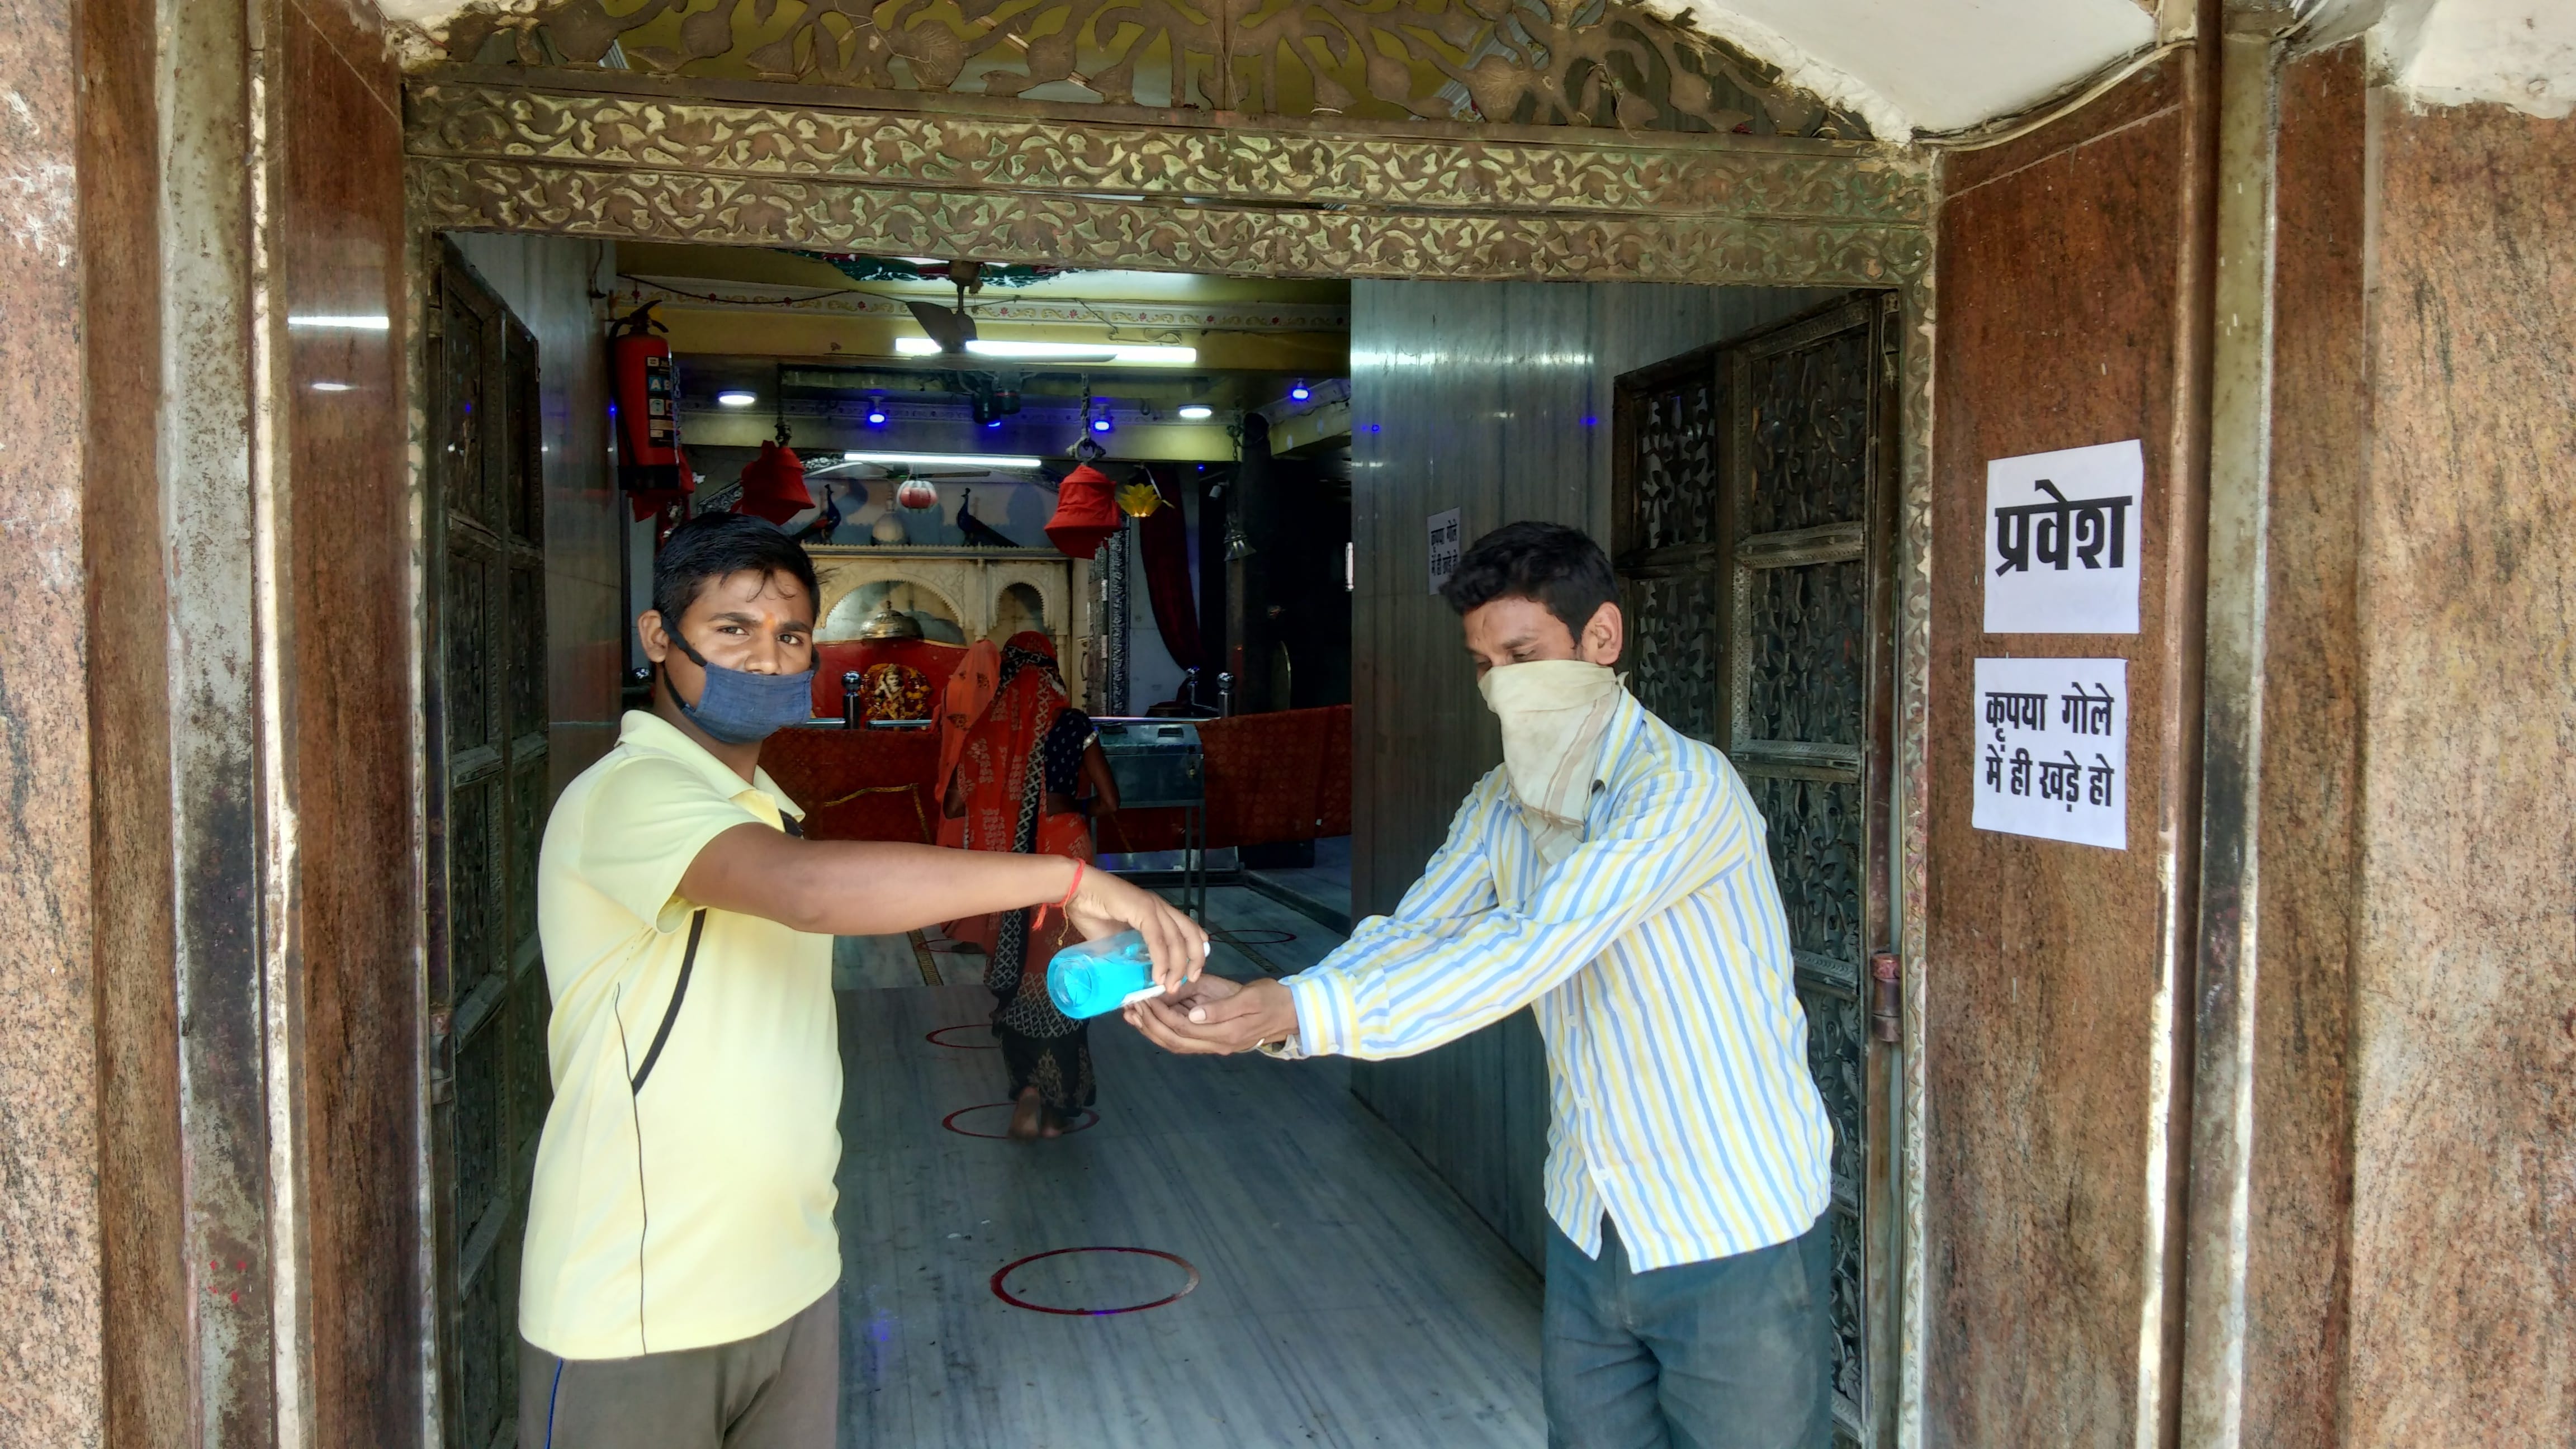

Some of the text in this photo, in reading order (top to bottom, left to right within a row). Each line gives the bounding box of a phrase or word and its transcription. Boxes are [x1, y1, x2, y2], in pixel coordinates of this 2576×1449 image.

[651, 379, 661, 390] A
[1995, 479, 2133, 577] प्रवेश
[1985, 681, 2115, 742] कृपया गोले
[2009, 747, 2033, 797] ही
[2038, 750, 2082, 812] खड़े
[2088, 752, 2115, 807] हो
